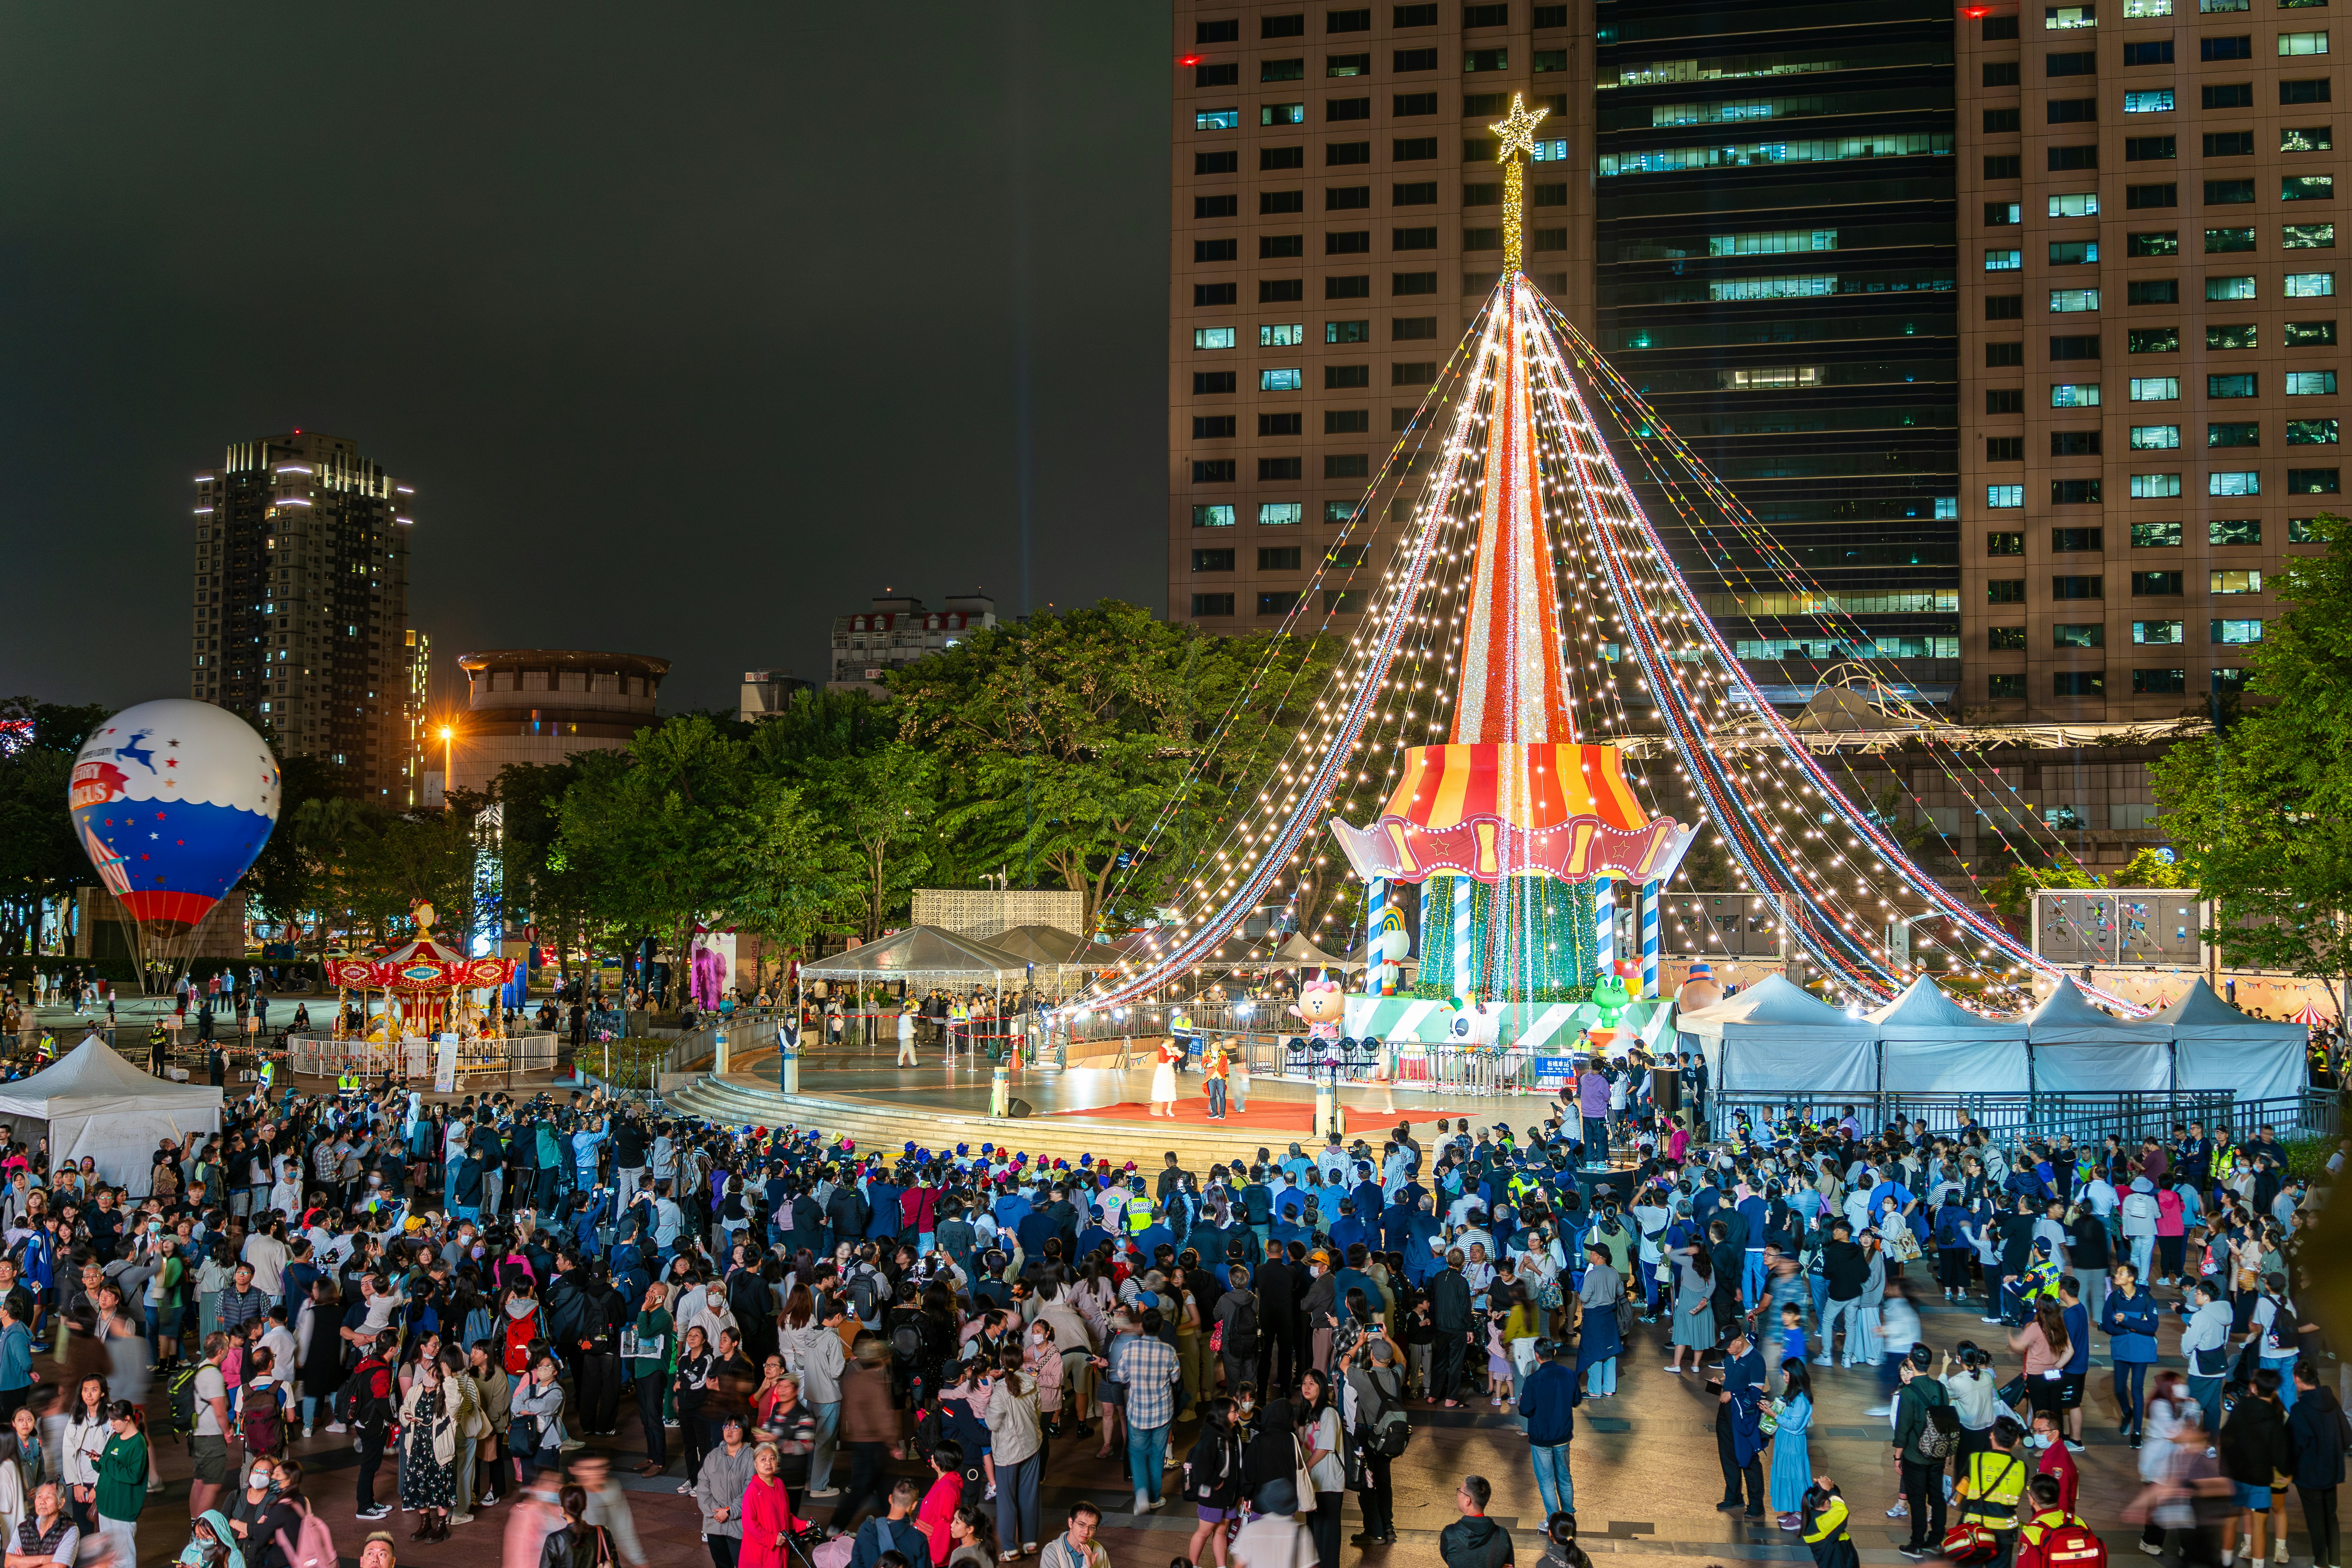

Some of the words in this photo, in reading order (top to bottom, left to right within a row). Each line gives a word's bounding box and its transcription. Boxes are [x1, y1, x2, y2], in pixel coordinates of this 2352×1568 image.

[74, 764, 102, 781] ERRY
[1981, 1465, 2018, 1477] 新北市防
